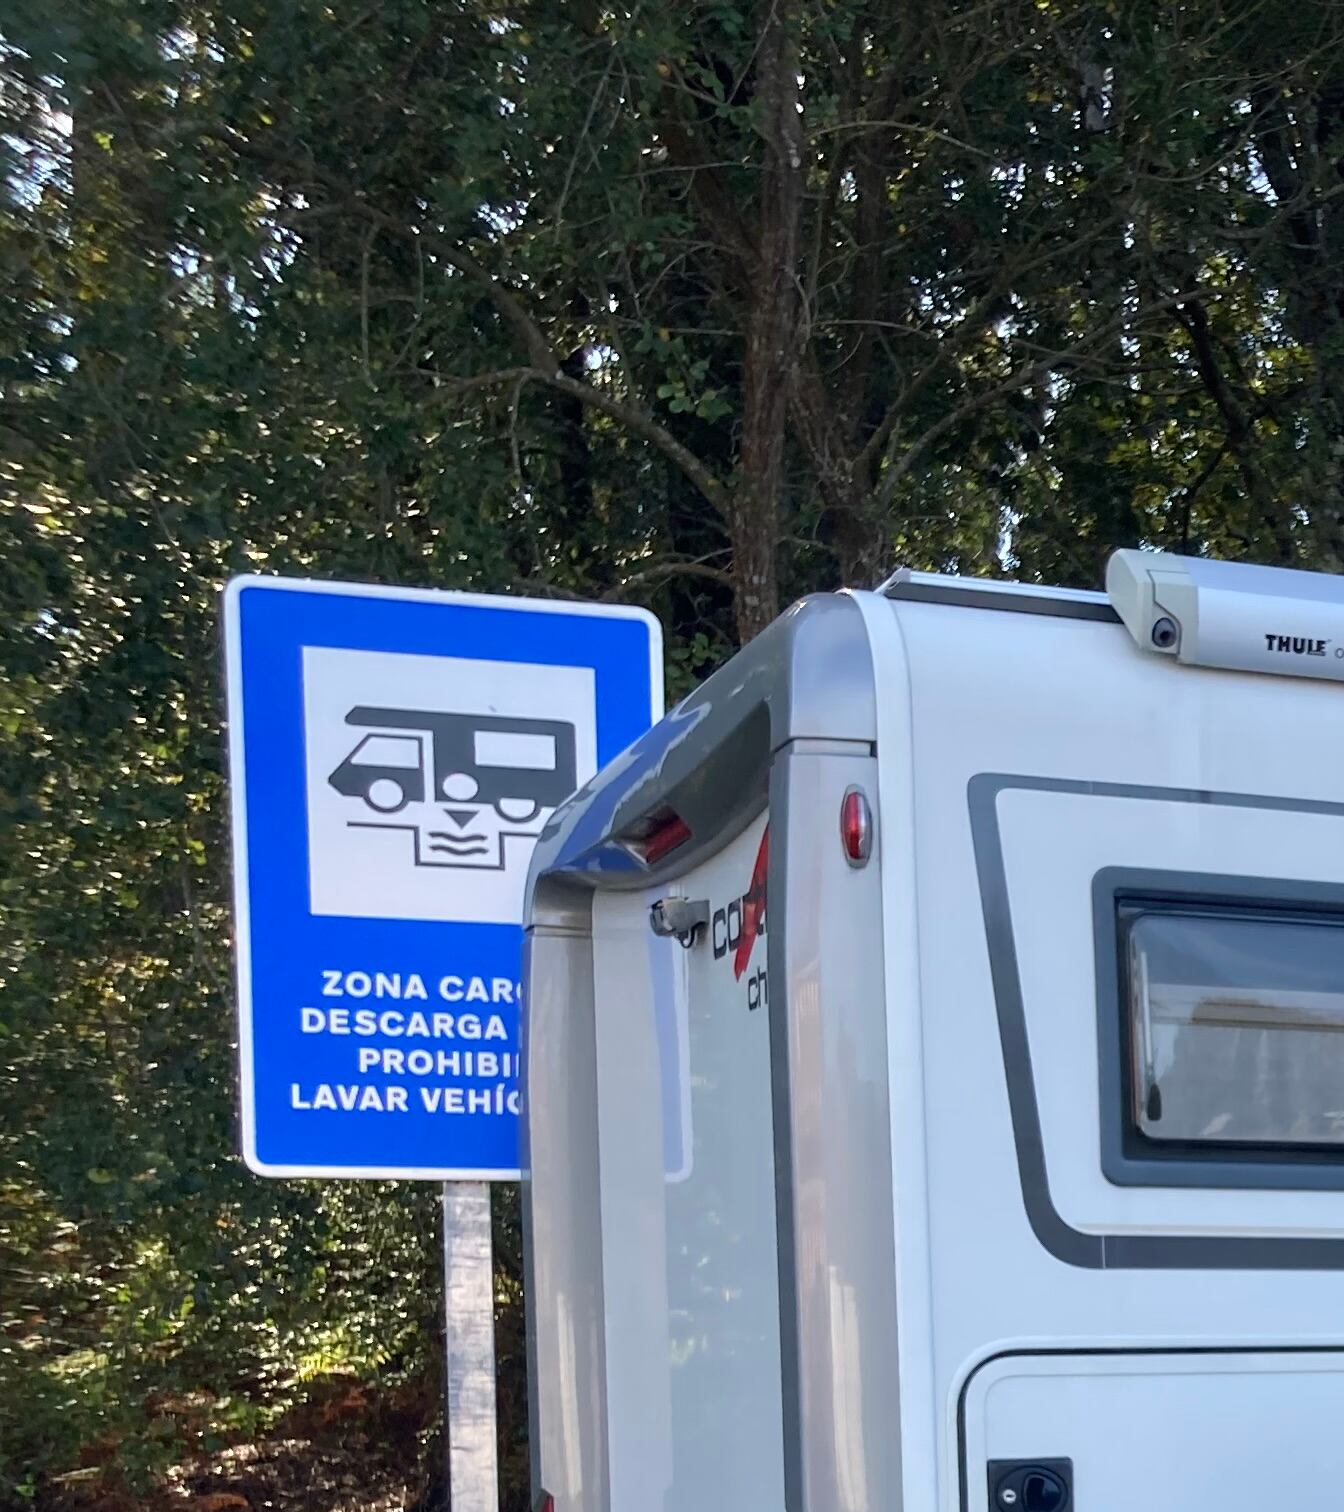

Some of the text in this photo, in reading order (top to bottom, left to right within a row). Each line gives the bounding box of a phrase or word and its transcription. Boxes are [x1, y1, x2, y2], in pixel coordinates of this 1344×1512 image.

[1265, 634, 1326, 656] THULE
[322, 969, 521, 1003] ZONA CAR
[301, 1007, 508, 1041] DESCARGA
[358, 1047, 519, 1078] PROHIBI
[291, 1083, 409, 1112] LAVAR
